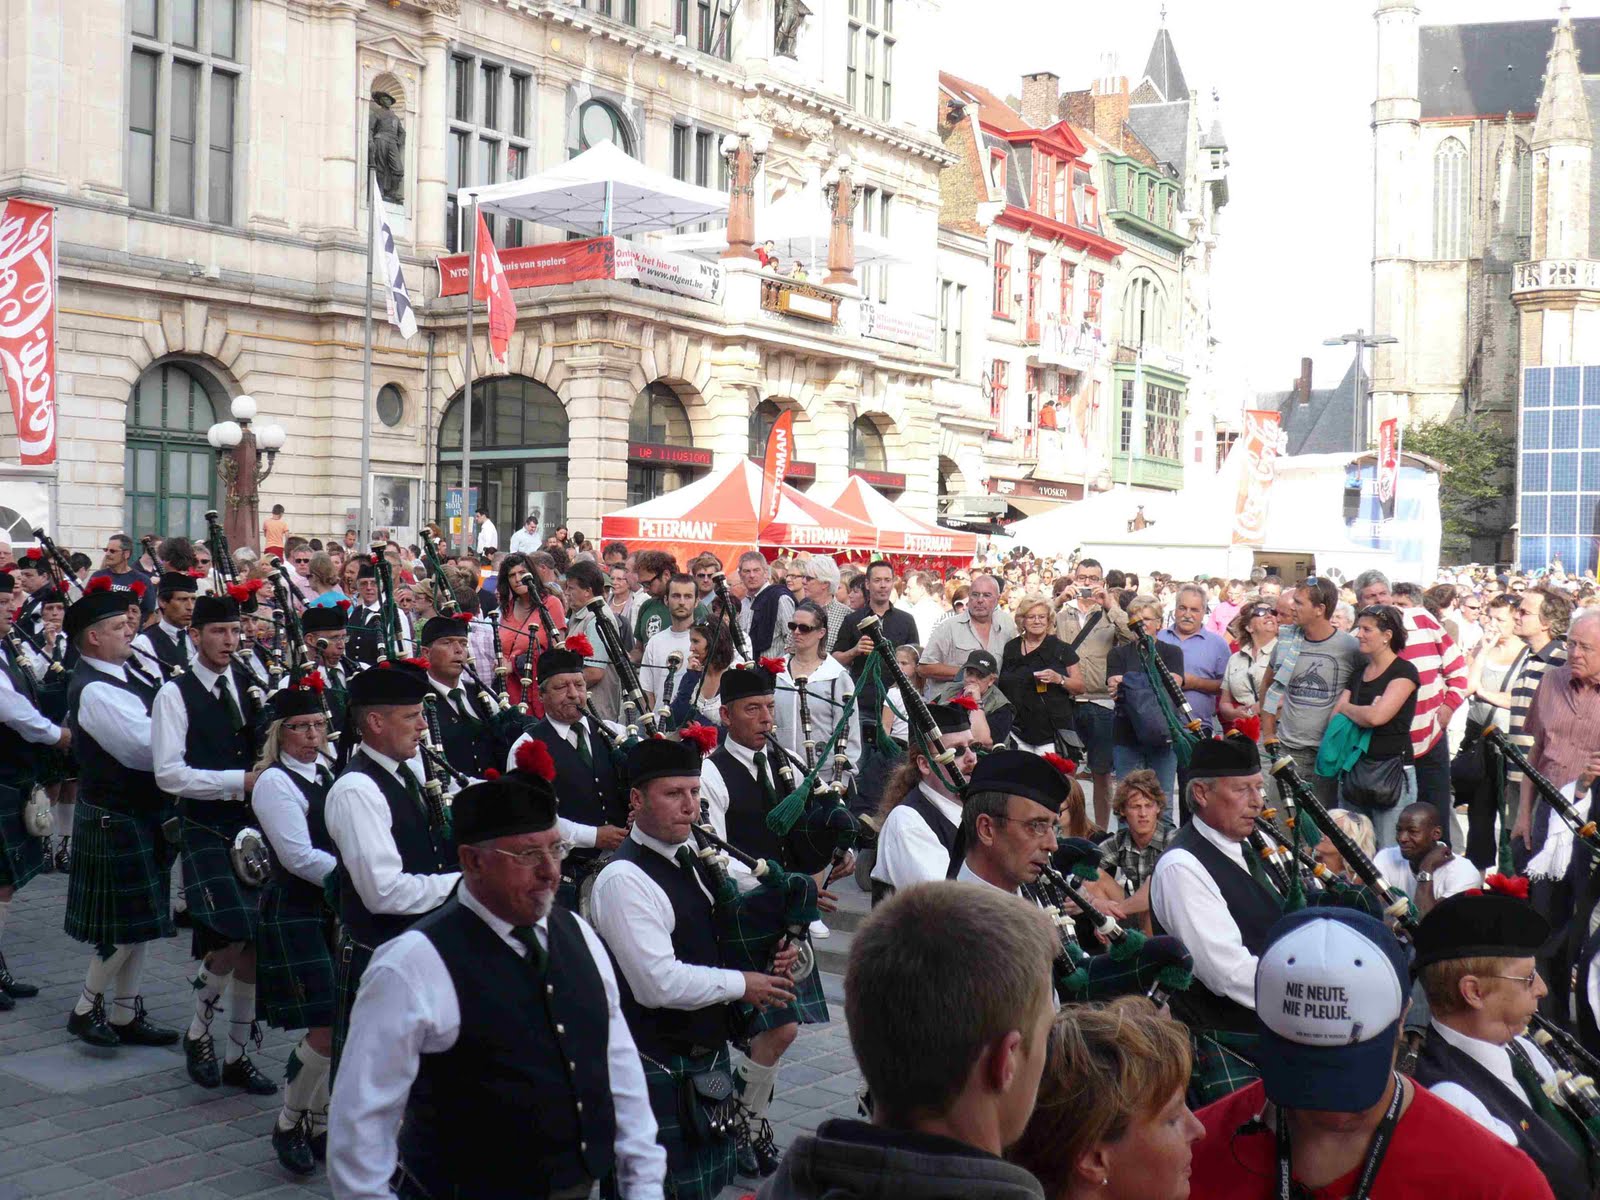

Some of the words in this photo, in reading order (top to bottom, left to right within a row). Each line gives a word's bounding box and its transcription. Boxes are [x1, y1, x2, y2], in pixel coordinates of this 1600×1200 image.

[520, 261, 535, 269] van
[537, 256, 566, 269] spelers
[642, 254, 655, 266] het
[656, 257, 671, 270] hier
[647, 267, 703, 289] www.ntgent.be
[700, 264, 720, 278] NTG
[1044, 486, 1068, 497] VOSKEN
[638, 518, 714, 541] PETERMAN
[790, 525, 849, 544] PETERMAN
[903, 533, 952, 550] PETERMAN
[1286, 981, 1303, 999] NIE
[1282, 999, 1300, 1016] NIE
